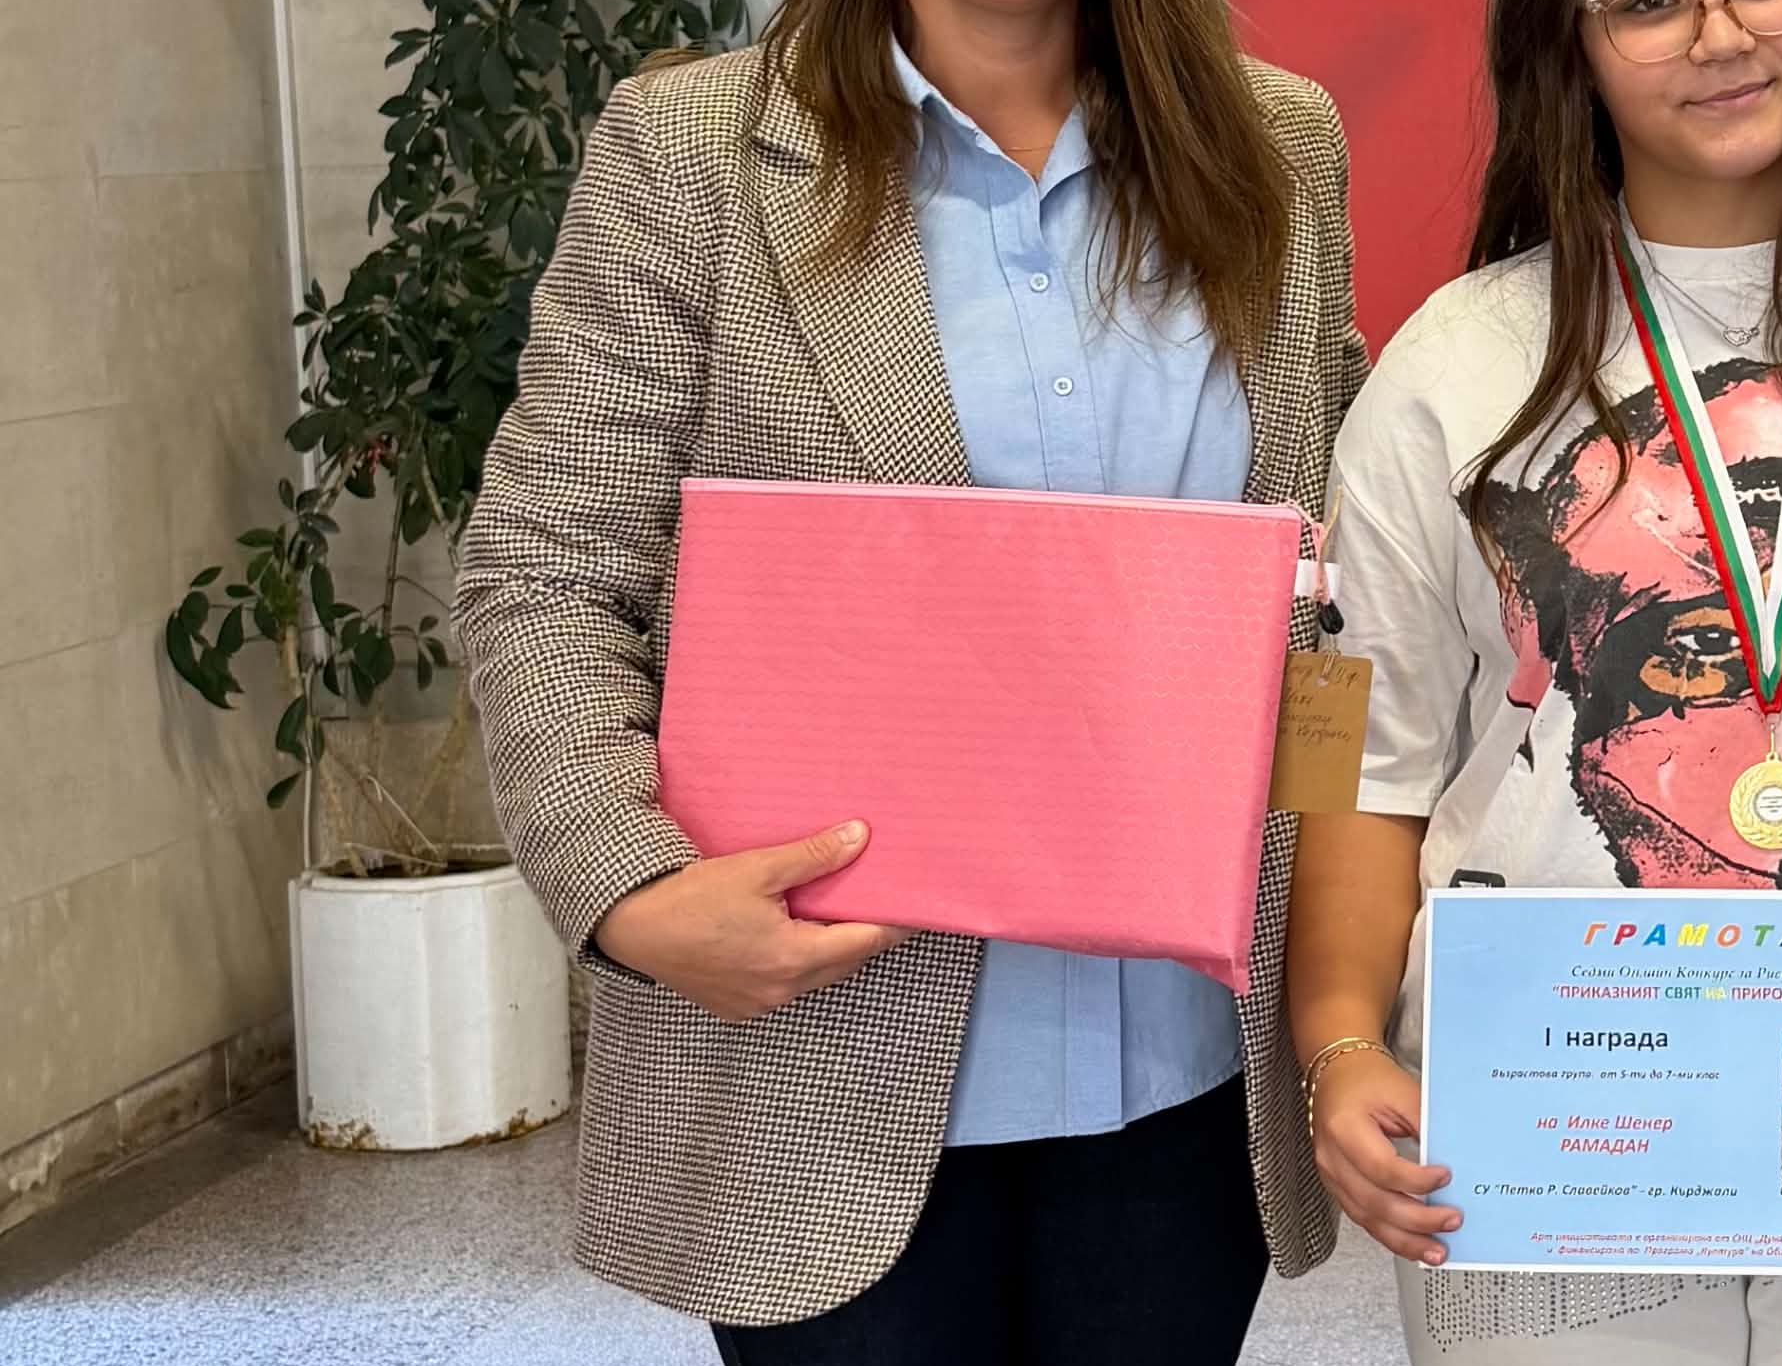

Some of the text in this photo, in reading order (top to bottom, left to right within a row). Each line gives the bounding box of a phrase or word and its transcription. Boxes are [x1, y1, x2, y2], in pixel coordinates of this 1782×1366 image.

[1664, 986, 1702, 1000] СВЯТ
[1566, 1031, 1669, 1051] награда
[1536, 1115, 1674, 1133] на Илке Шенер
[1560, 1138, 1650, 1155] РАМАДАН
[1474, 1184, 1491, 1195] СУ
[1547, 1184, 1559, 1196] Р.
[1670, 1185, 1738, 1197] Кърджали
